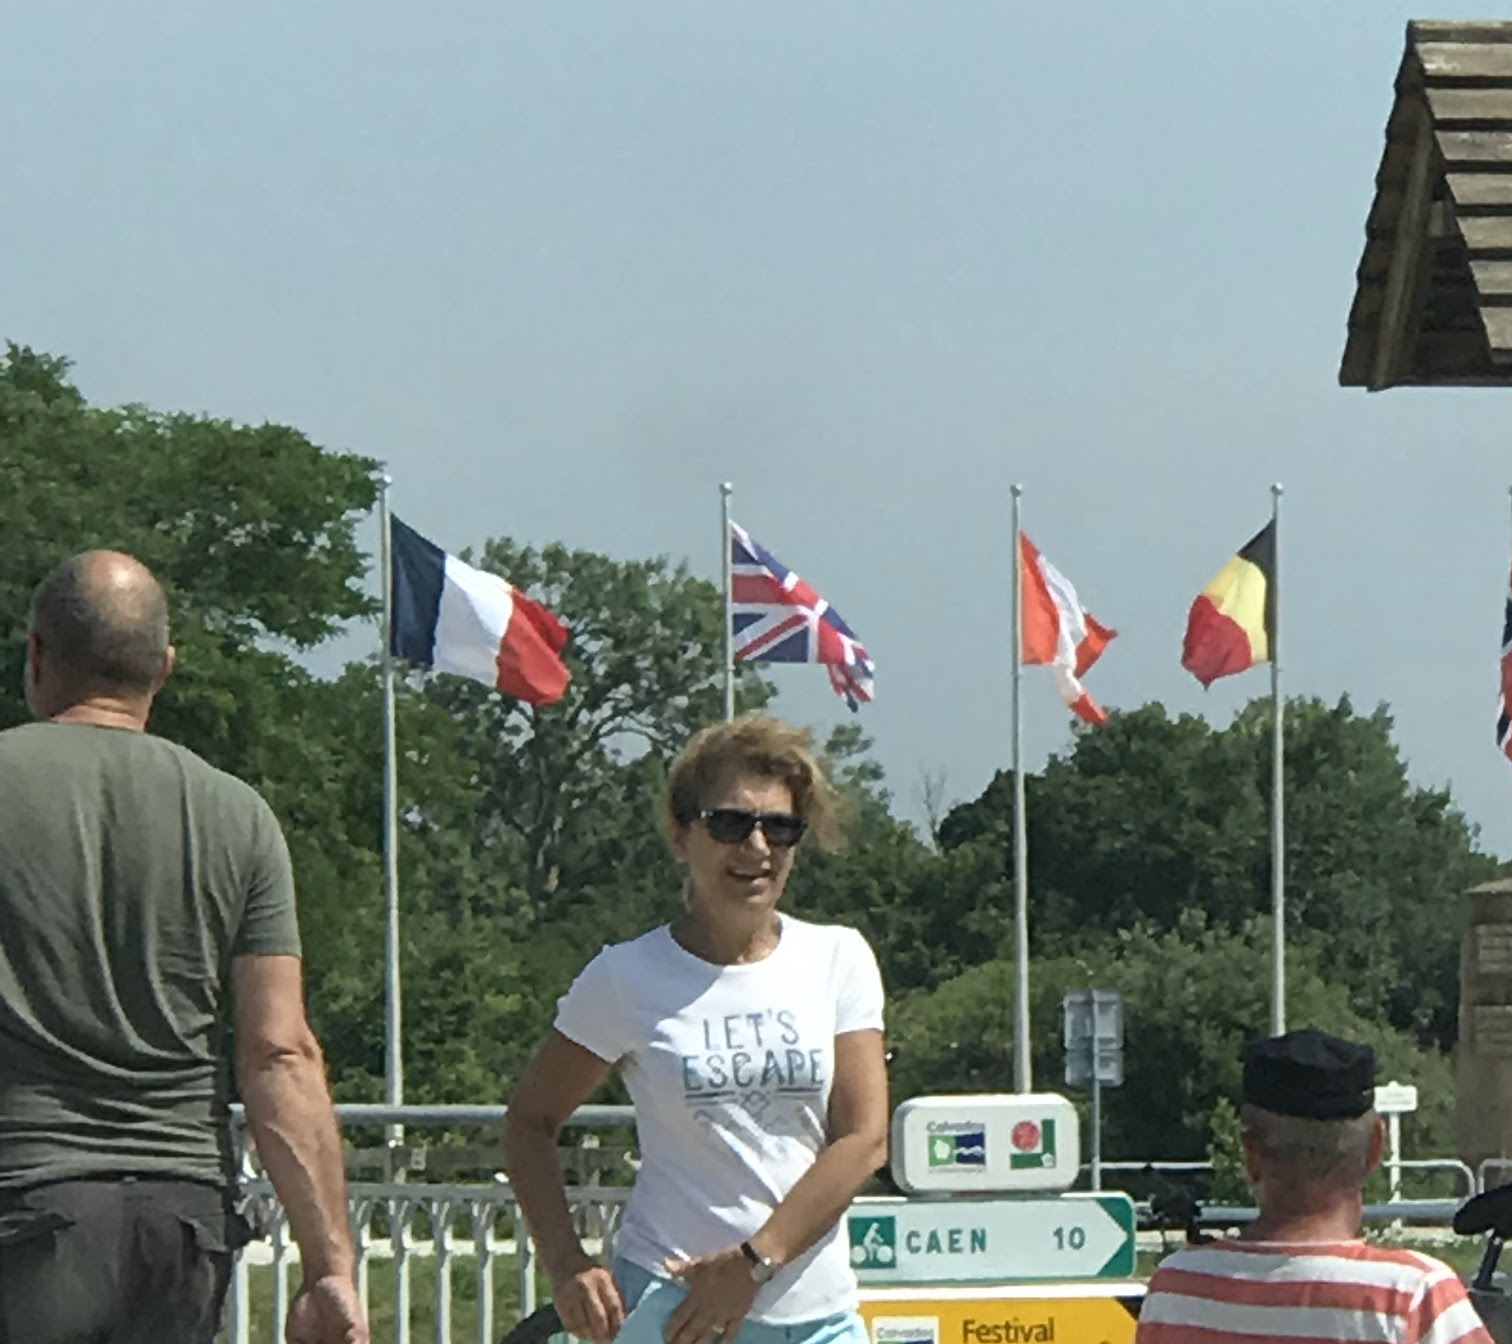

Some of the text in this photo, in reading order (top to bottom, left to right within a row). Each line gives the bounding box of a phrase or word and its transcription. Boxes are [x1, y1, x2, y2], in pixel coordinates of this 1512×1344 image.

[703, 1009, 799, 1050] LET'S
[682, 1049, 824, 1090] ESCAPE
[906, 1226, 1086, 1254] CAEN 10
[962, 1317, 1055, 1344] Festival
